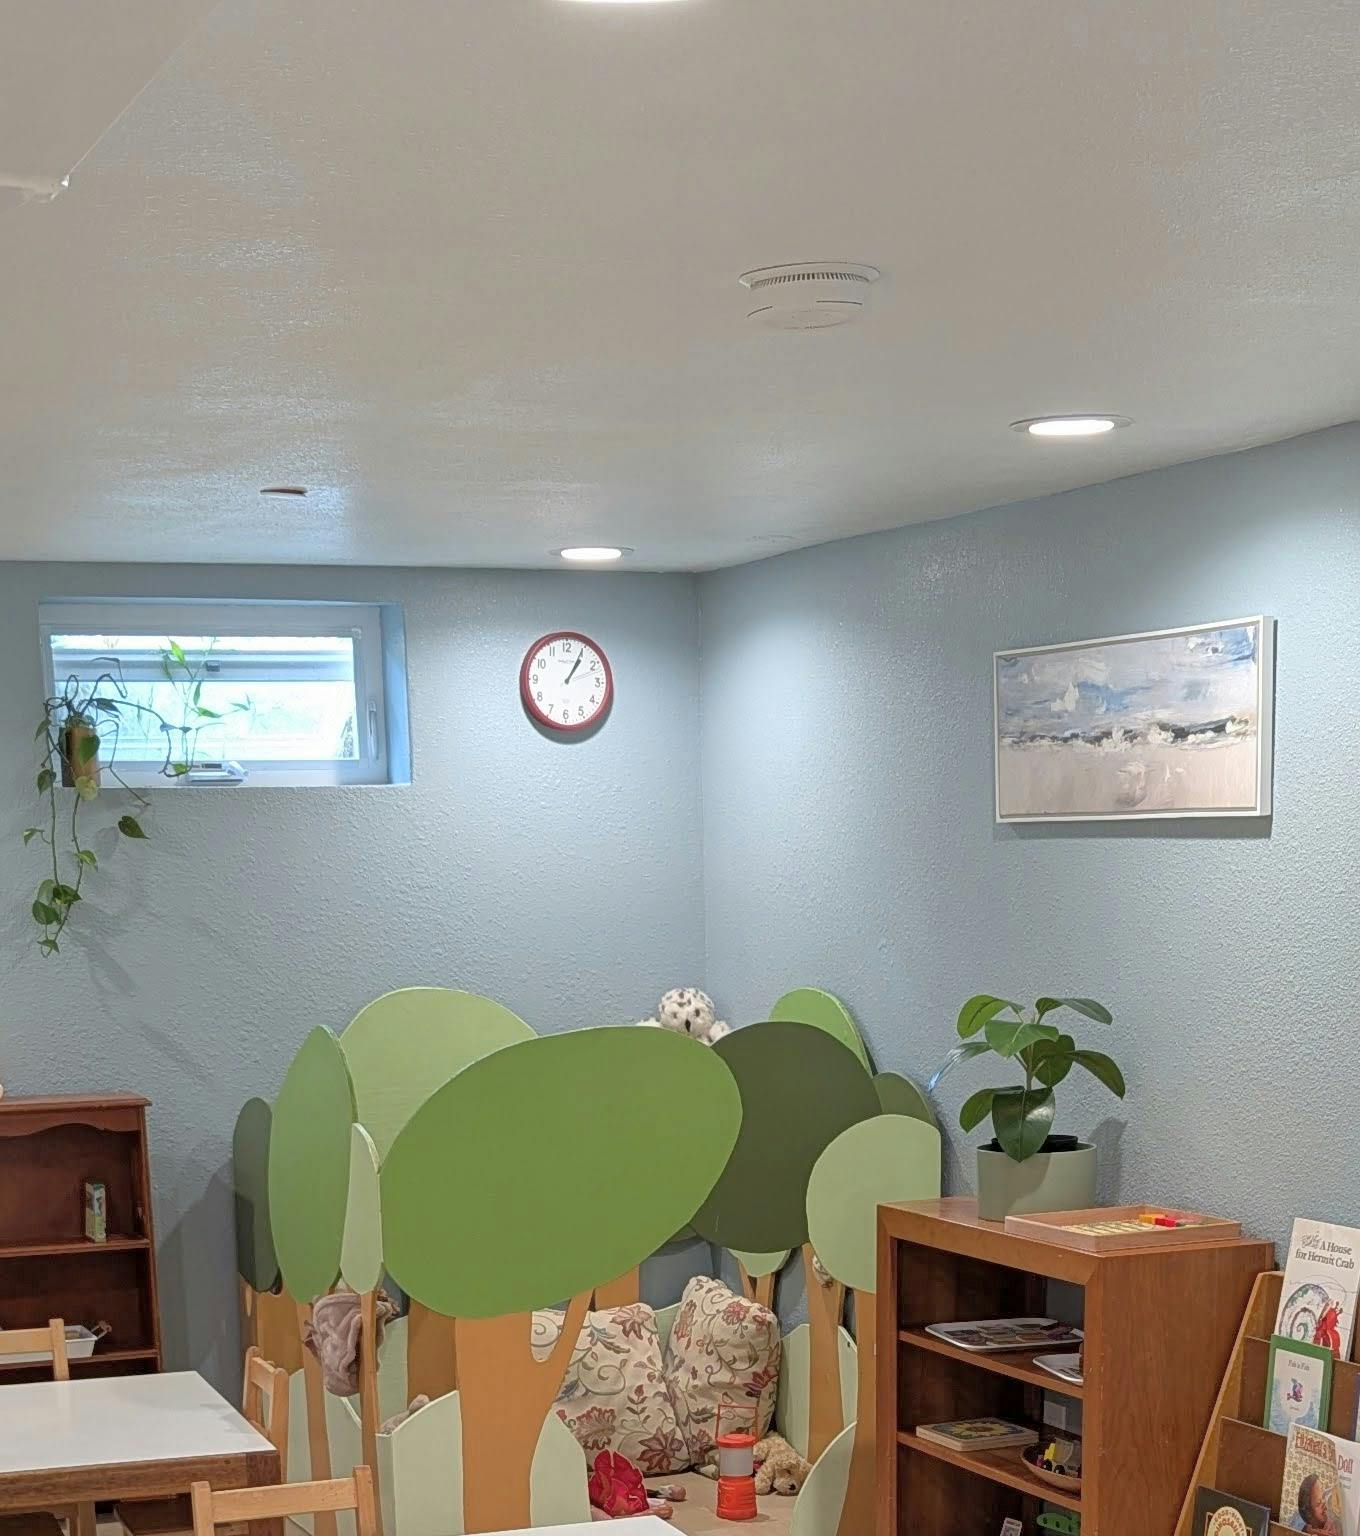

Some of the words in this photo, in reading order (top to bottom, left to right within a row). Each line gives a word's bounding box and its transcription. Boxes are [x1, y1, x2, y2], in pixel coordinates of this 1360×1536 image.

[548, 646, 556, 657] 11
[562, 642, 572, 653] 12
[537, 658, 546, 669] 10
[589, 660, 597, 672] 2
[532, 674, 539, 685] 9
[594, 677, 601, 688] 3
[536, 691, 543, 702] 8
[589, 694, 596, 706] 4
[547, 704, 554, 715] 7
[562, 709, 570, 720] 6
[577, 706, 585, 717] 5
[1320, 1241, 1326, 1251] A
[1327, 1242, 1353, 1255] House
[1295, 1248, 1308, 1260] for
[1307, 1251, 1336, 1266] Hermit
[1336, 1257, 1355, 1270] Crab
[1337, 1454, 1354, 1475] Doll
